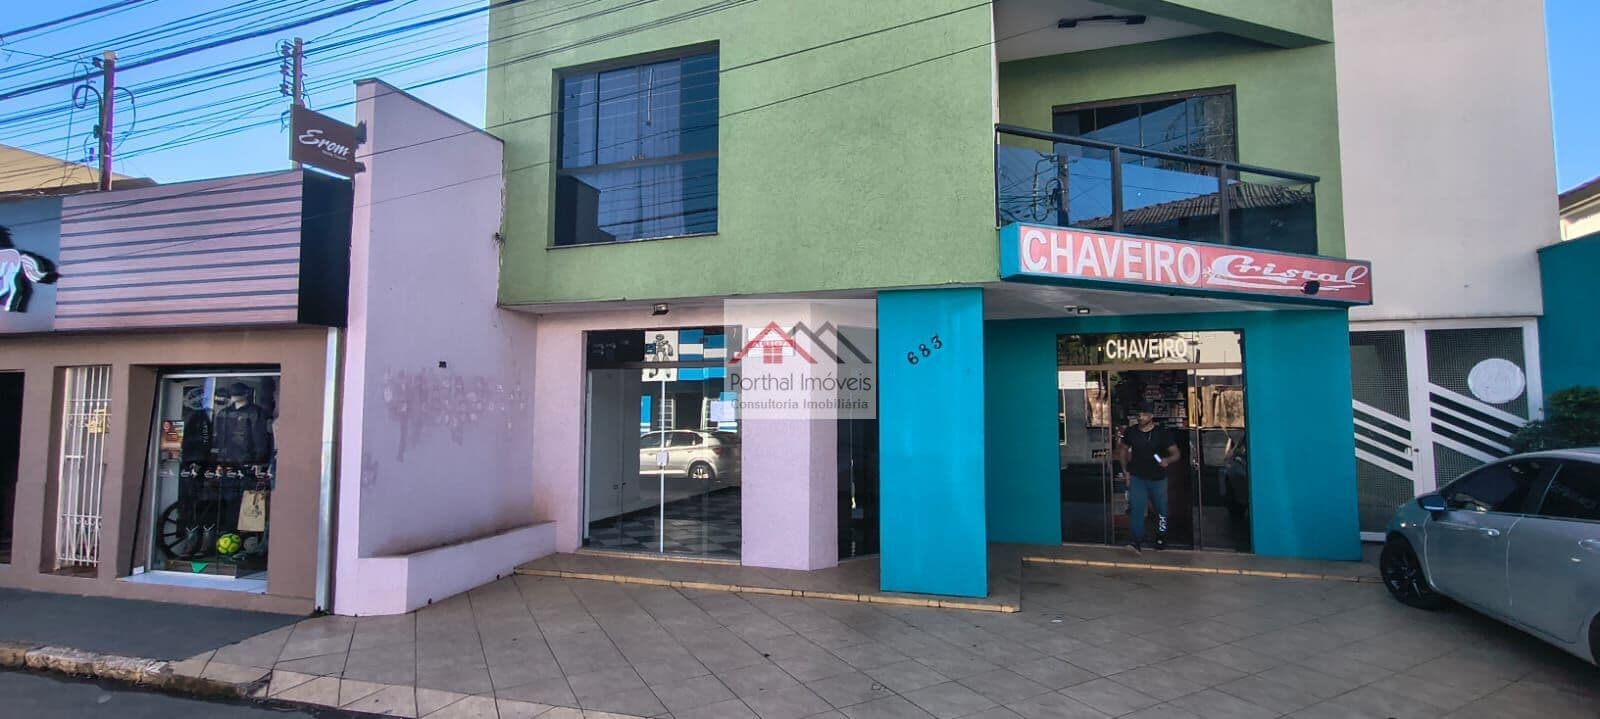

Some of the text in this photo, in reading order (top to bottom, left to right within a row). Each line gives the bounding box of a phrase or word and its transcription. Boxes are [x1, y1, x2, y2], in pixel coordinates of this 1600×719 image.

[1021, 229, 1368, 286] CHAVEIRO Cristal
[907, 335, 943, 365] 683
[1105, 337, 1188, 359] CHAVEIRO
